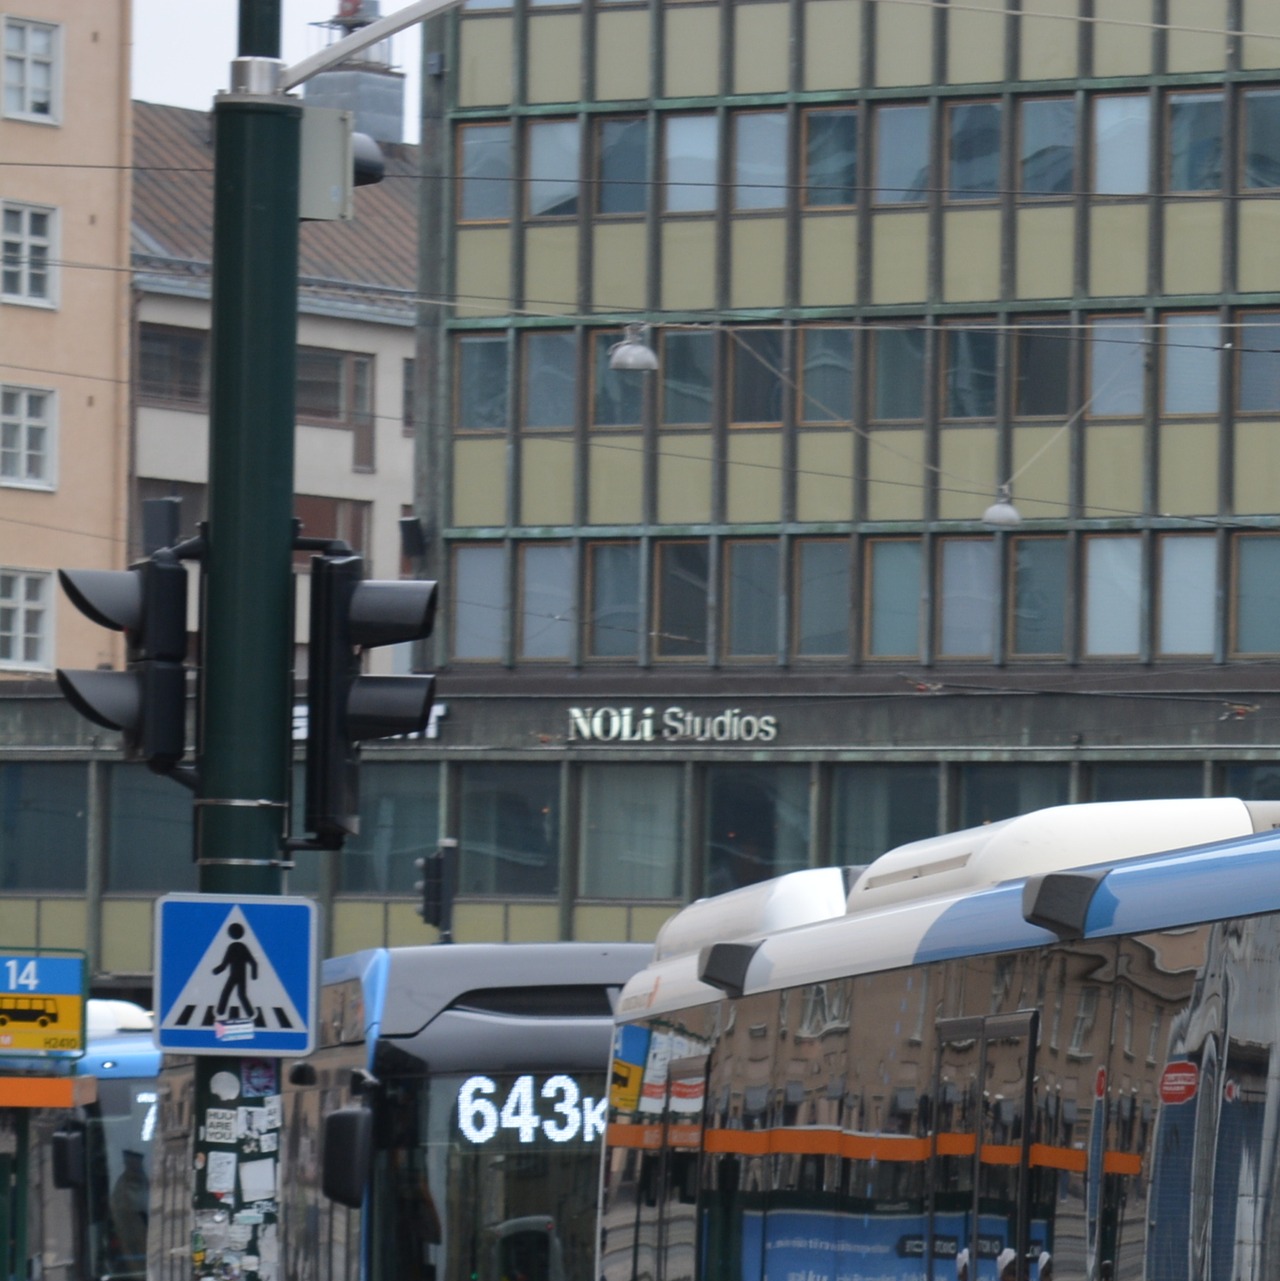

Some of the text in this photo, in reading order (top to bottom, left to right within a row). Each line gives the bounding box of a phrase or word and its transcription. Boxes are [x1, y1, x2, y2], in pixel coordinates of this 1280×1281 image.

[567, 706, 777, 741] NOLi Studios
[5, 960, 39, 990] 14
[458, 1074, 608, 1143] 643K
[208, 1121, 232, 1131] ARE
